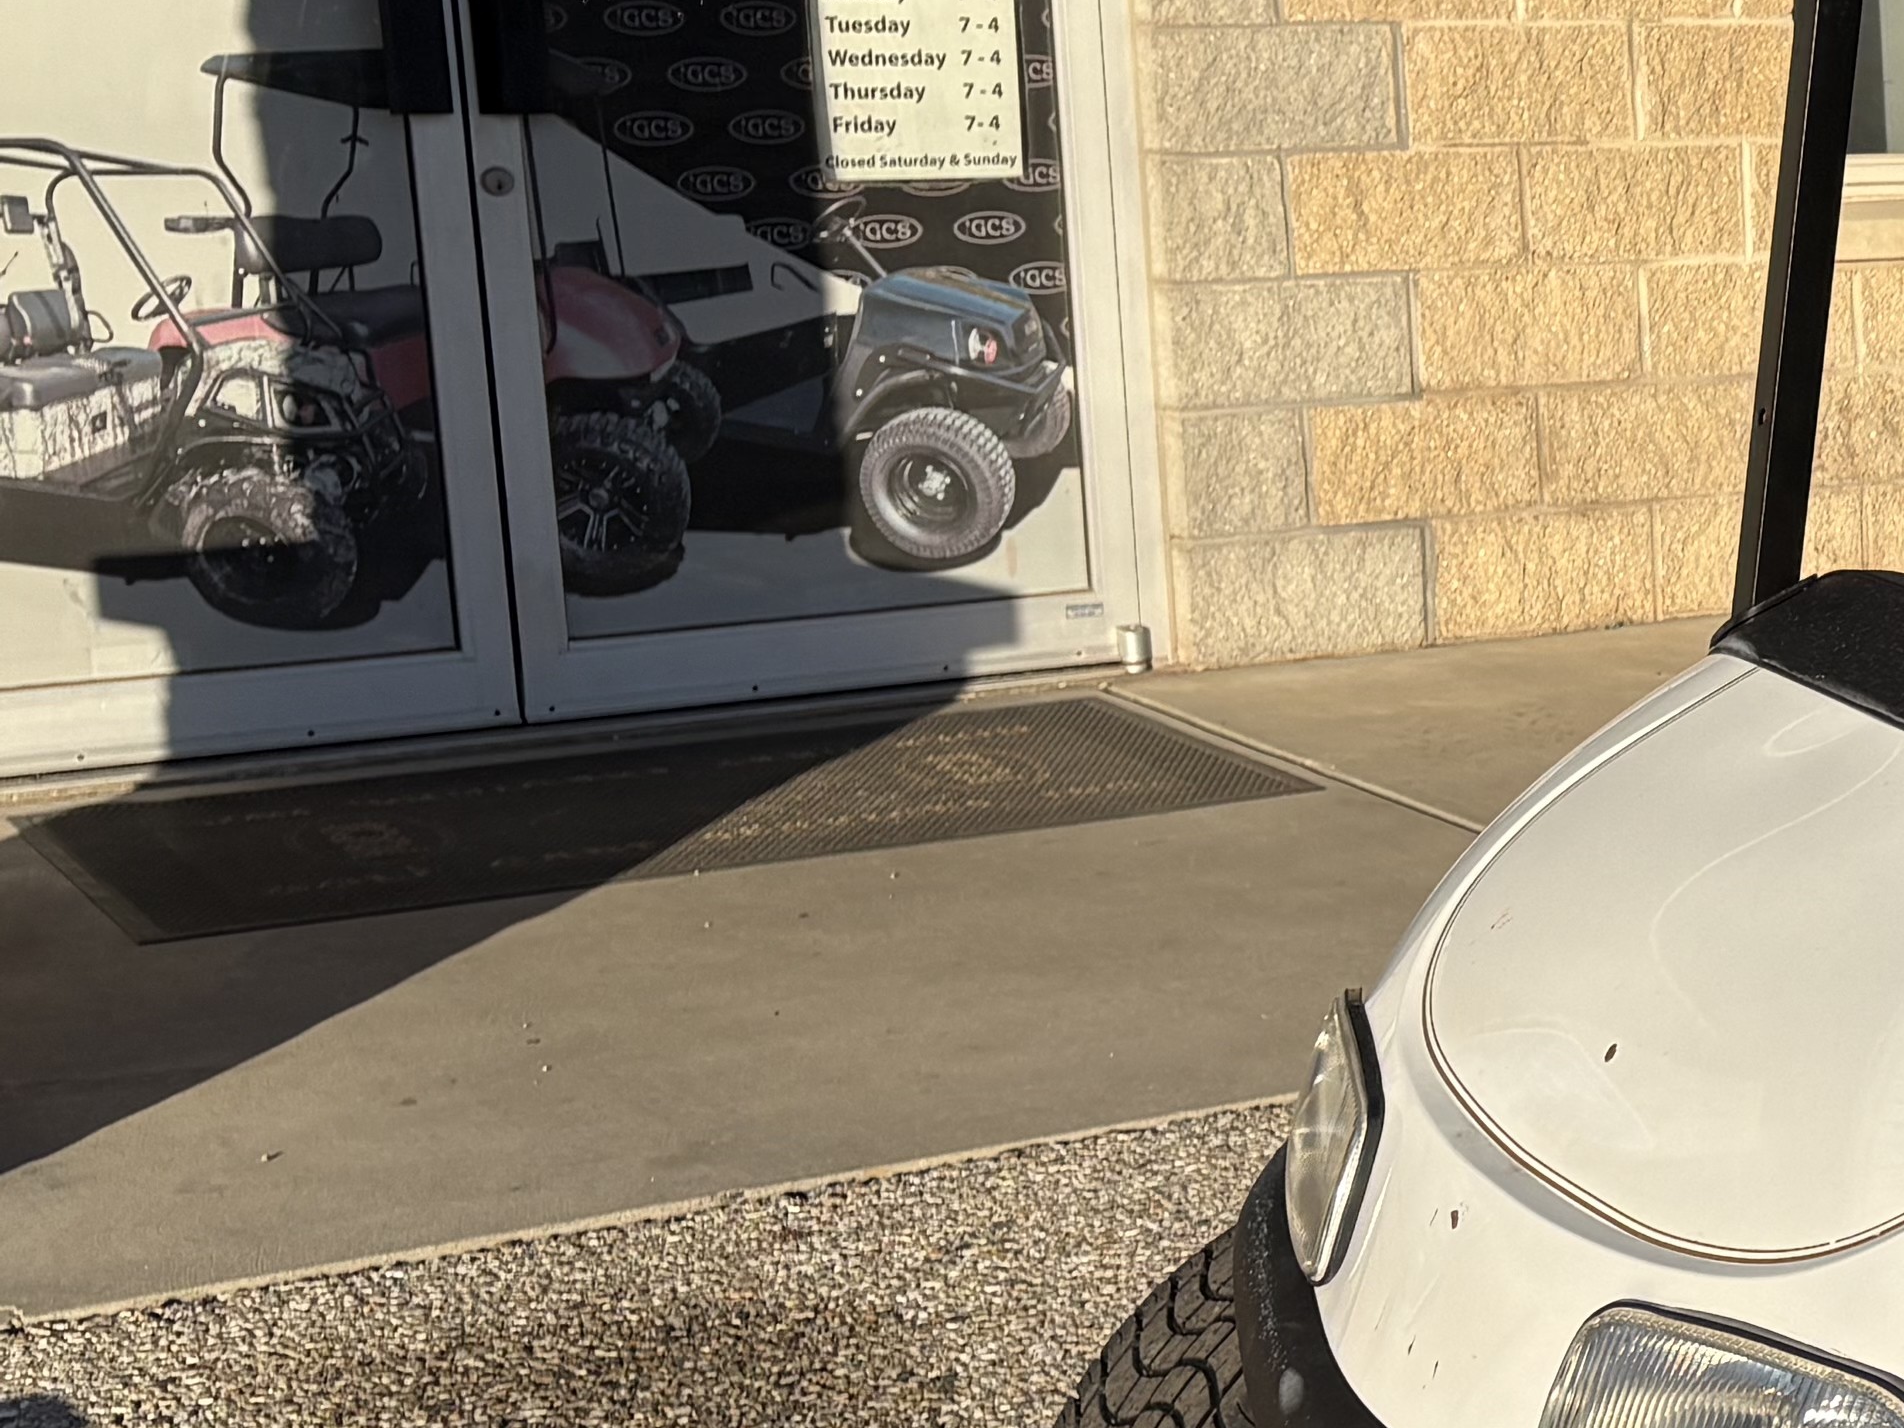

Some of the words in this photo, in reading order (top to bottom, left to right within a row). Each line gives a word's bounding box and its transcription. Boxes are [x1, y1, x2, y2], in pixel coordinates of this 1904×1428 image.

[622, 9, 674, 28] GCS
[737, 9, 786, 28] GCS
[824, 15, 910, 37] Tuesday
[959, 16, 970, 33] 7
[988, 16, 1000, 33] 4
[828, 48, 947, 71] Wednesday
[961, 49, 972, 66] 7
[989, 49, 1002, 66] 4
[686, 65, 736, 84] GCS
[829, 81, 926, 104] Thursday
[963, 82, 974, 99] 7
[991, 82, 1003, 99] 4
[632, 119, 682, 139] GCS
[747, 118, 795, 138] GCS
[832, 114, 897, 137] Friday
[825, 154, 876, 169] Closed
[879, 152, 946, 170] Saturday
[950, 154, 960, 167] &
[963, 152, 1018, 168] Sunday
[699, 174, 744, 193] GCS
[866, 222, 912, 240] GCS
[970, 217, 1015, 237] GCS
